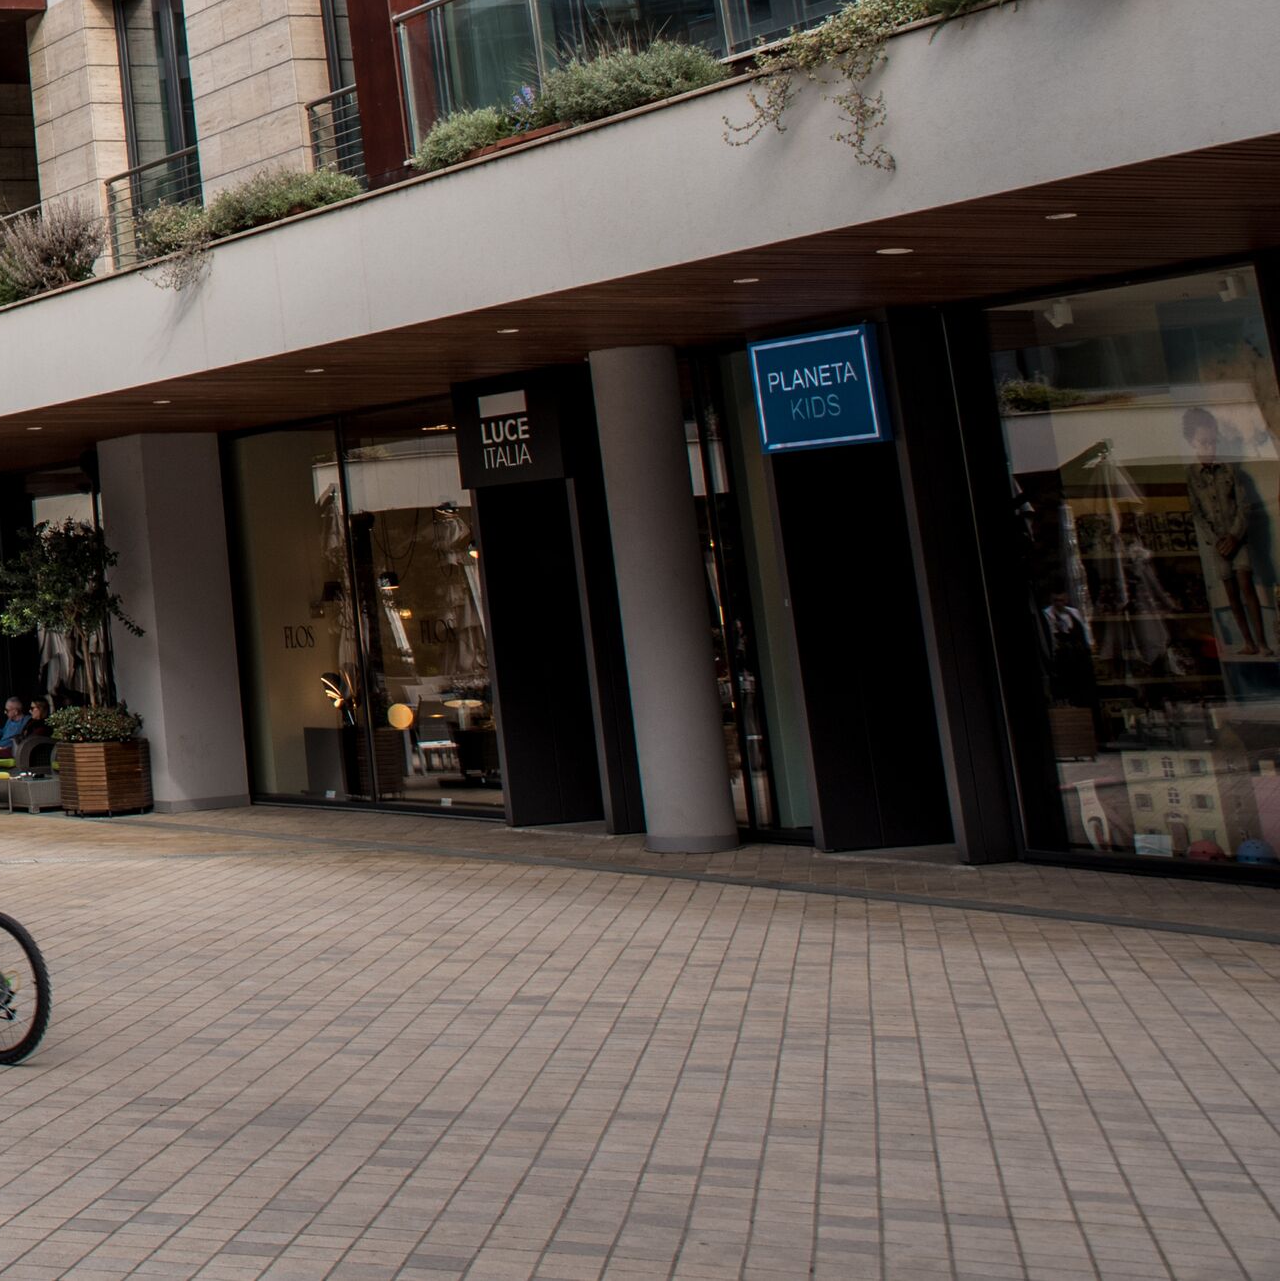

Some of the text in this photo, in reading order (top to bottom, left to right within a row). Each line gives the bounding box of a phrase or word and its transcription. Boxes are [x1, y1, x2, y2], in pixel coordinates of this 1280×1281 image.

[766, 361, 858, 394] PLANETA
[790, 394, 841, 421] KIDS
[480, 417, 530, 444] LUCE
[483, 443, 532, 469] ITALIA
[284, 625, 315, 648] FLOS
[420, 619, 456, 644] FLOS
